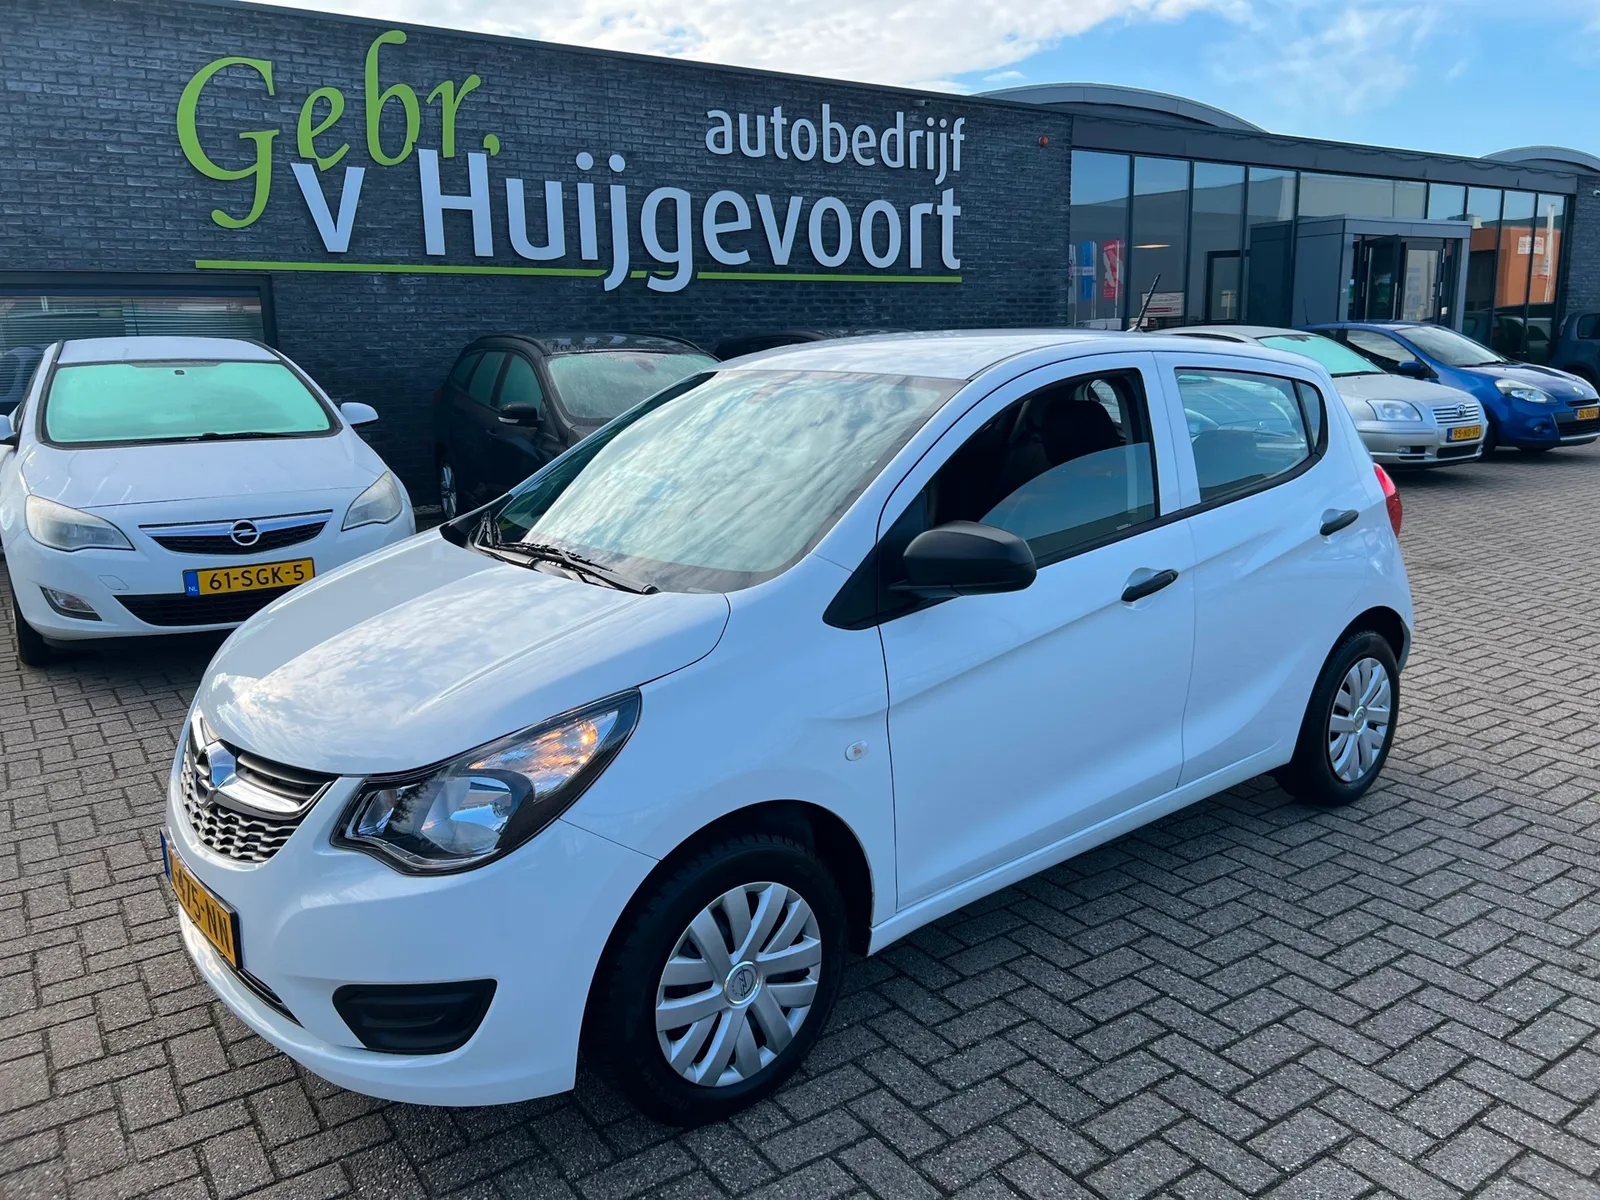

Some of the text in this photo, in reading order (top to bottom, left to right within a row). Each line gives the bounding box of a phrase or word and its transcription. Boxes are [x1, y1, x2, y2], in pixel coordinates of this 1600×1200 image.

[705, 103, 965, 185] autobedrijf
[418, 149, 961, 292] Huijgevoort
[209, 564, 305, 590] 61-SGK-5
